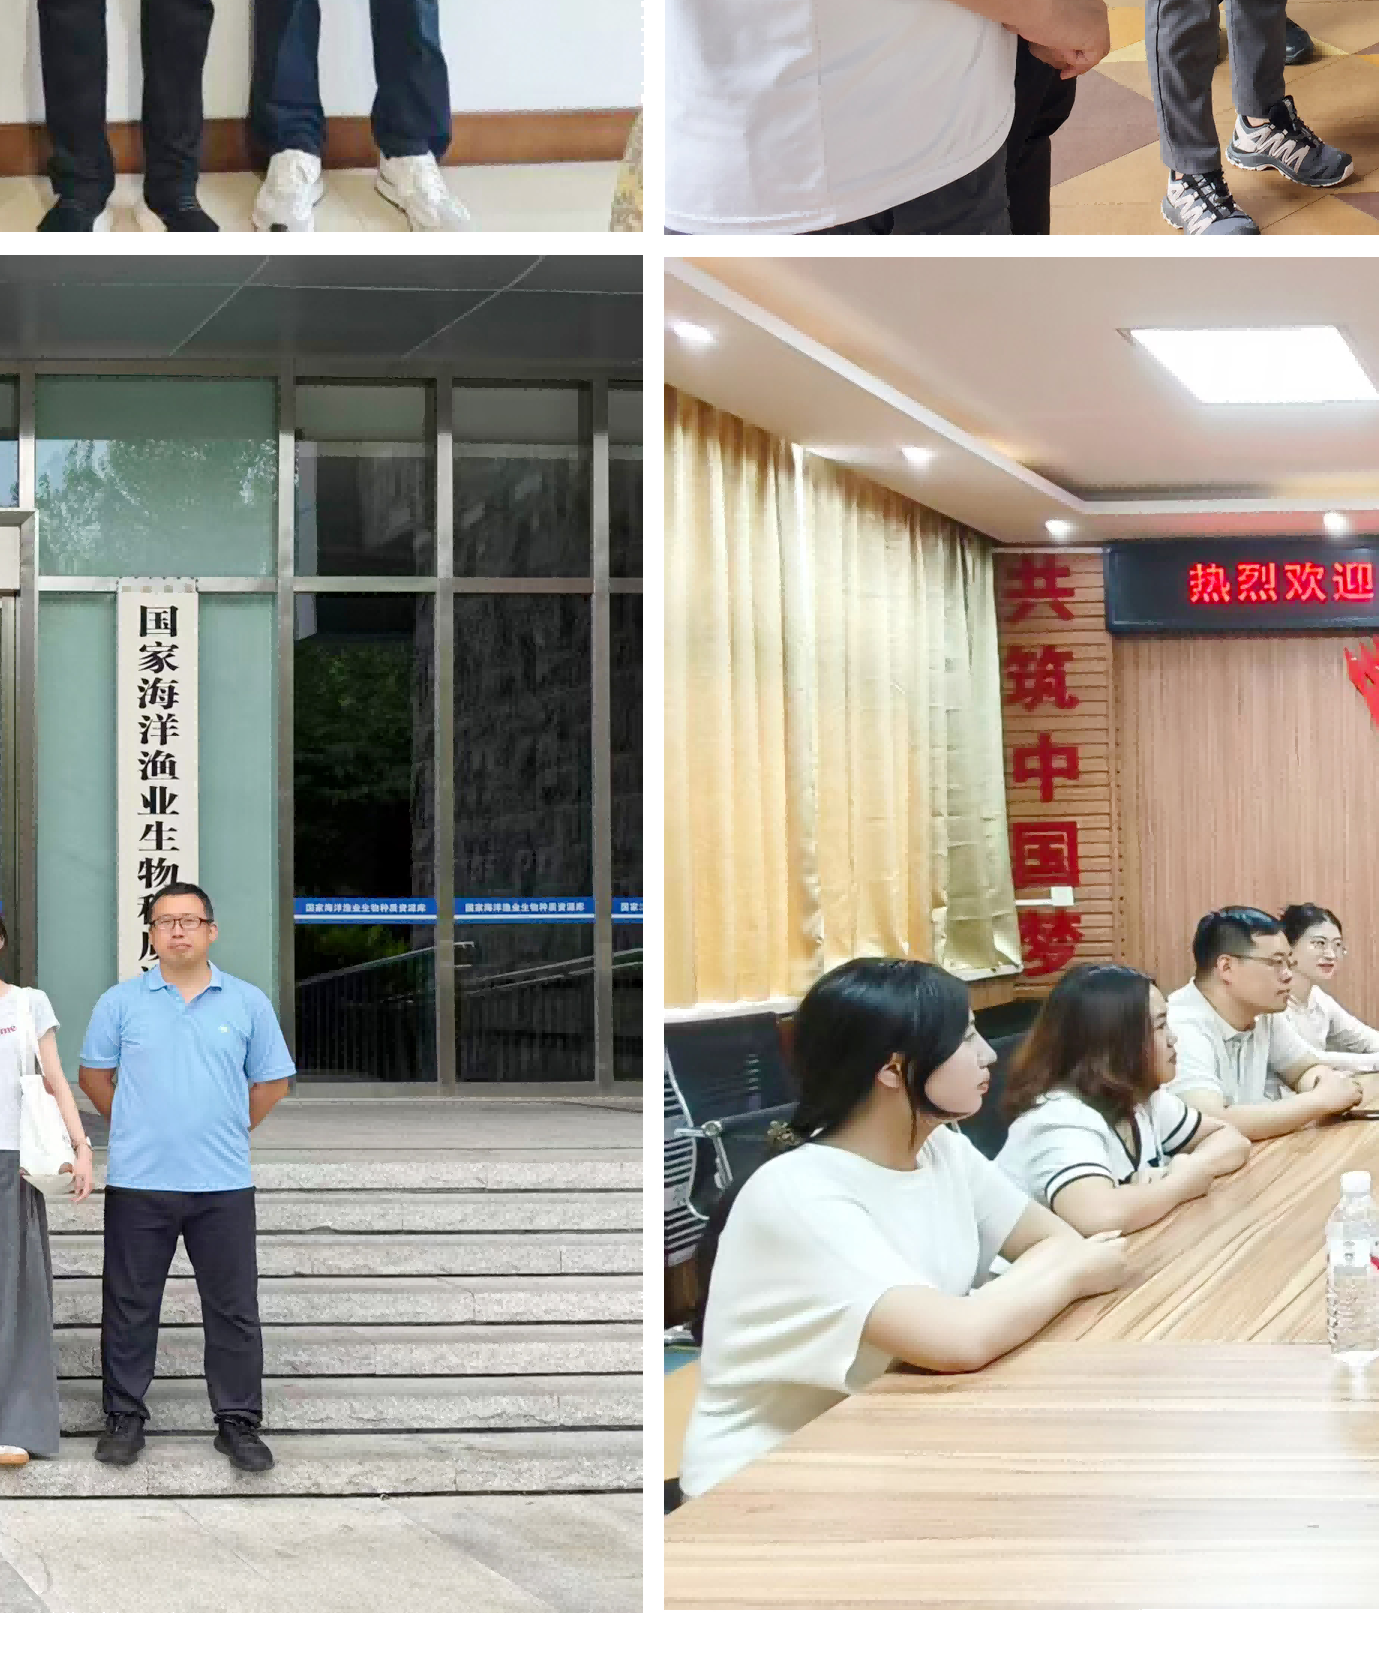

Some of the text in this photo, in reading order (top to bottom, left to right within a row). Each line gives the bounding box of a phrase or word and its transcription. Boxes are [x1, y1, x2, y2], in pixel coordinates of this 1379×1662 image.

[136, 604, 180, 976] 国家海洋渔业生物
[1004, 553, 1083, 977] 共筑中国梦
[305, 903, 426, 913] 国家海洋渔业生物种质资源库
[465, 902, 585, 912] 国家海洋渔业生物种质资源库
